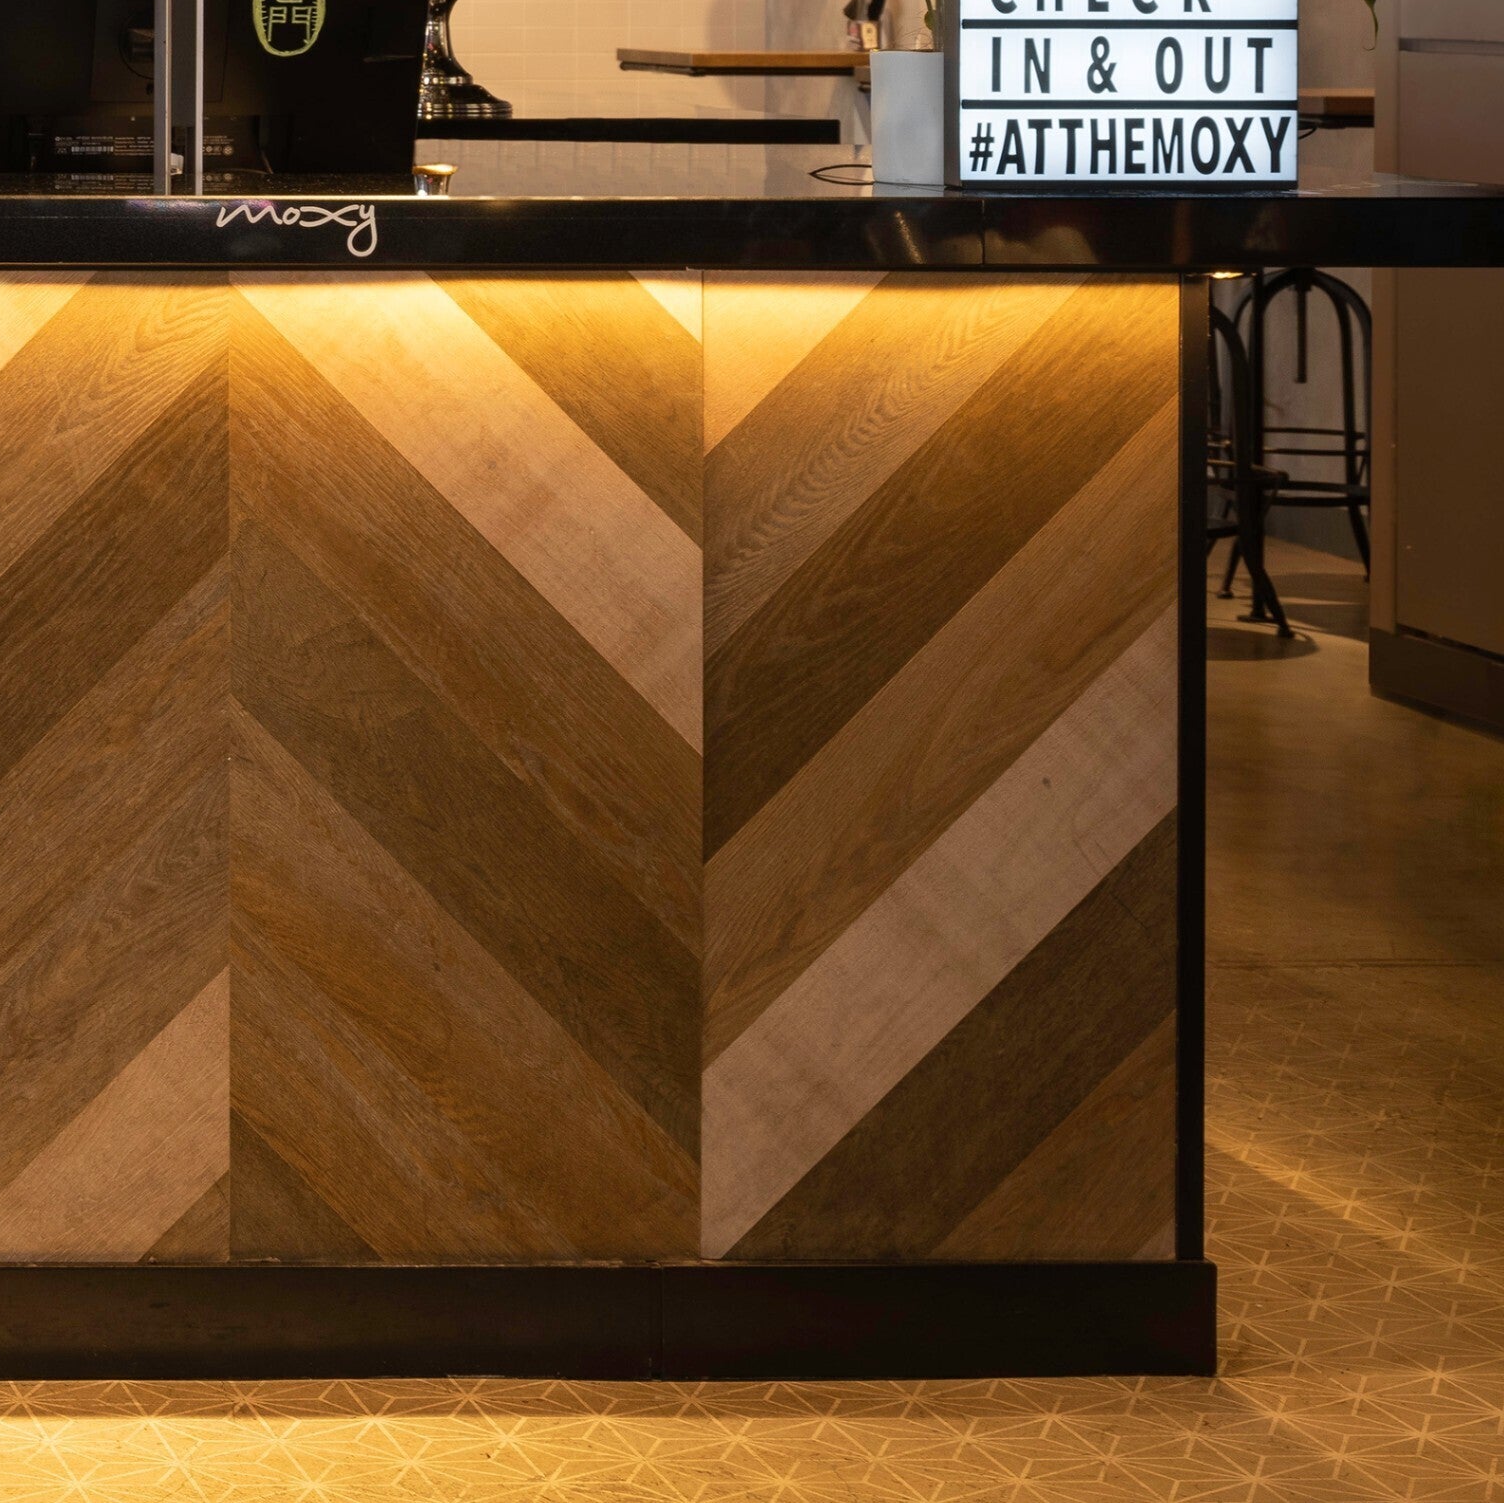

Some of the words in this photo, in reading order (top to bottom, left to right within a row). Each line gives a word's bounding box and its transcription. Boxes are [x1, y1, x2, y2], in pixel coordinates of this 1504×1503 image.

[990, 36, 1052, 94] IN
[1086, 42, 1118, 94] &
[1155, 37, 1274, 94] OUT
[969, 115, 1291, 177] #ATTHEMOXY
